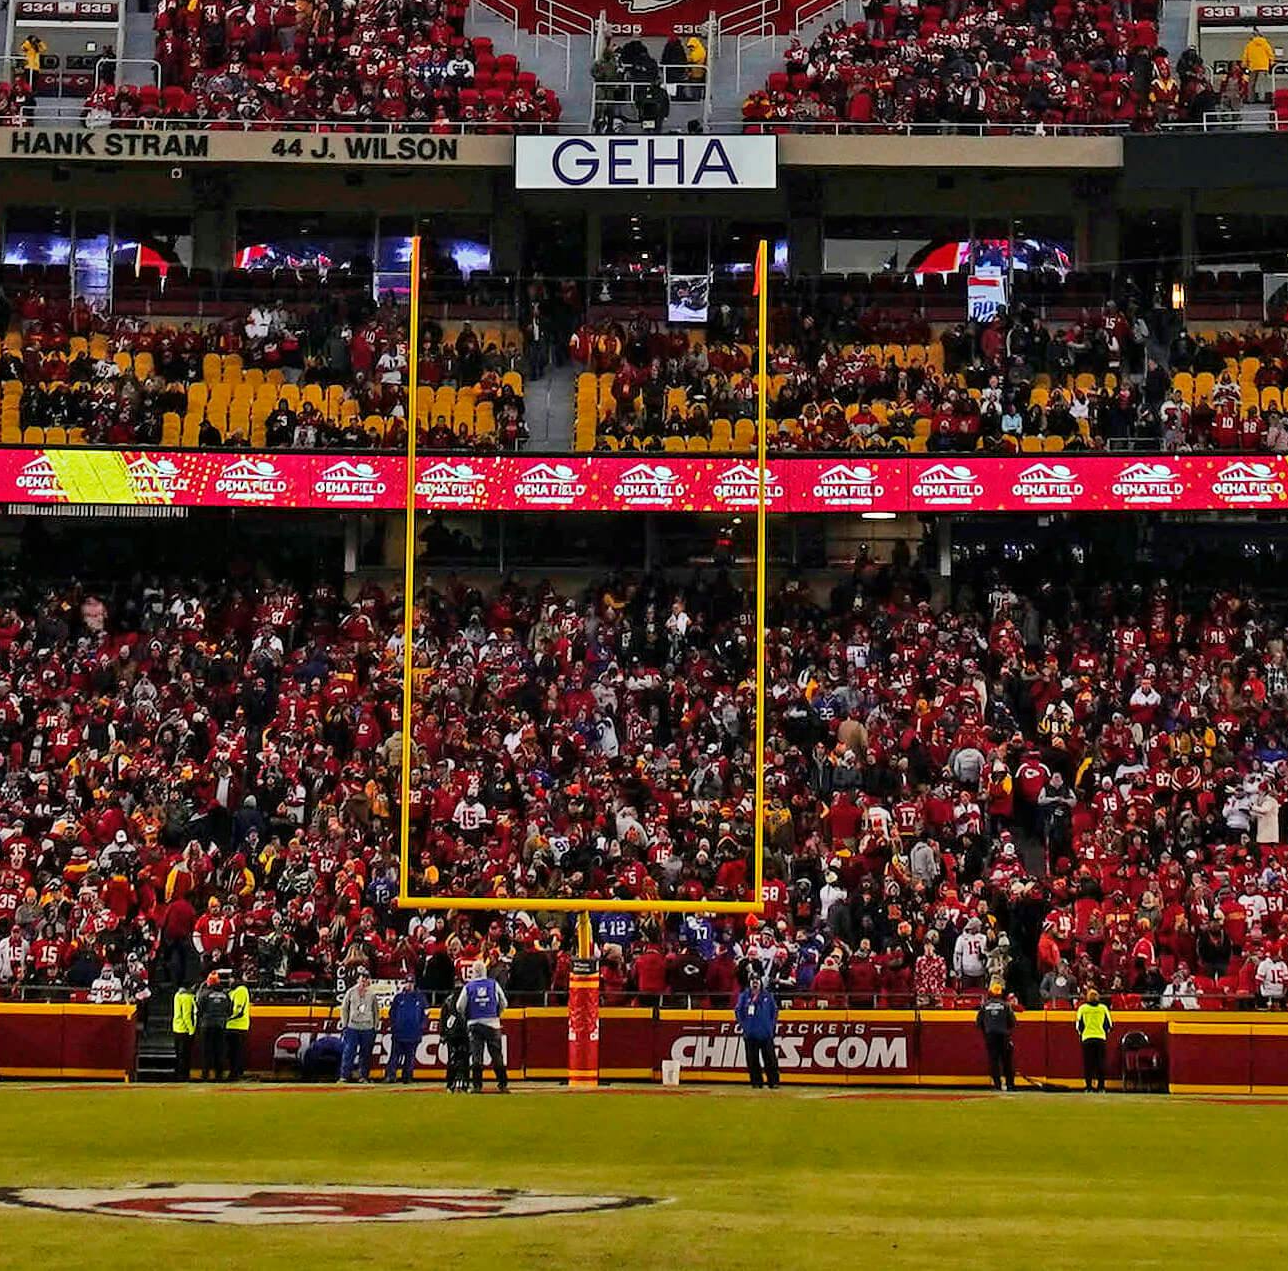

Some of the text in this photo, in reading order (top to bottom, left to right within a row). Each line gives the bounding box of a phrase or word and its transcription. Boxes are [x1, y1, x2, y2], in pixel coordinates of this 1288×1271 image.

[22, 2, 54, 13] 334
[11, 131, 208, 157] HANK STRAM
[271, 138, 457, 161] 44 J. WILSON
[552, 139, 738, 186] GEHA
[315, 481, 386, 494] GEHA FIELD
[813, 485, 884, 497] GEHA FIELD
[912, 485, 983, 497] GEHA FIELD
[1012, 484, 1083, 496] GEHA FIELD
[1112, 483, 1183, 495] GEHA FIELD
[820, 708, 834, 720] 22
[1157, 774, 1170, 786] 87
[463, 811, 476, 826] 15
[902, 813, 914, 826] 17
[376, 890, 389, 903] 12
[209, 920, 223, 934] 87
[610, 921, 625, 935] 12
[41, 947, 57, 962] 15
[968, 942, 979, 954] 15
[775, 1023, 865, 1034] TICKETS
[671, 1036, 907, 1068] CHIS.COM
